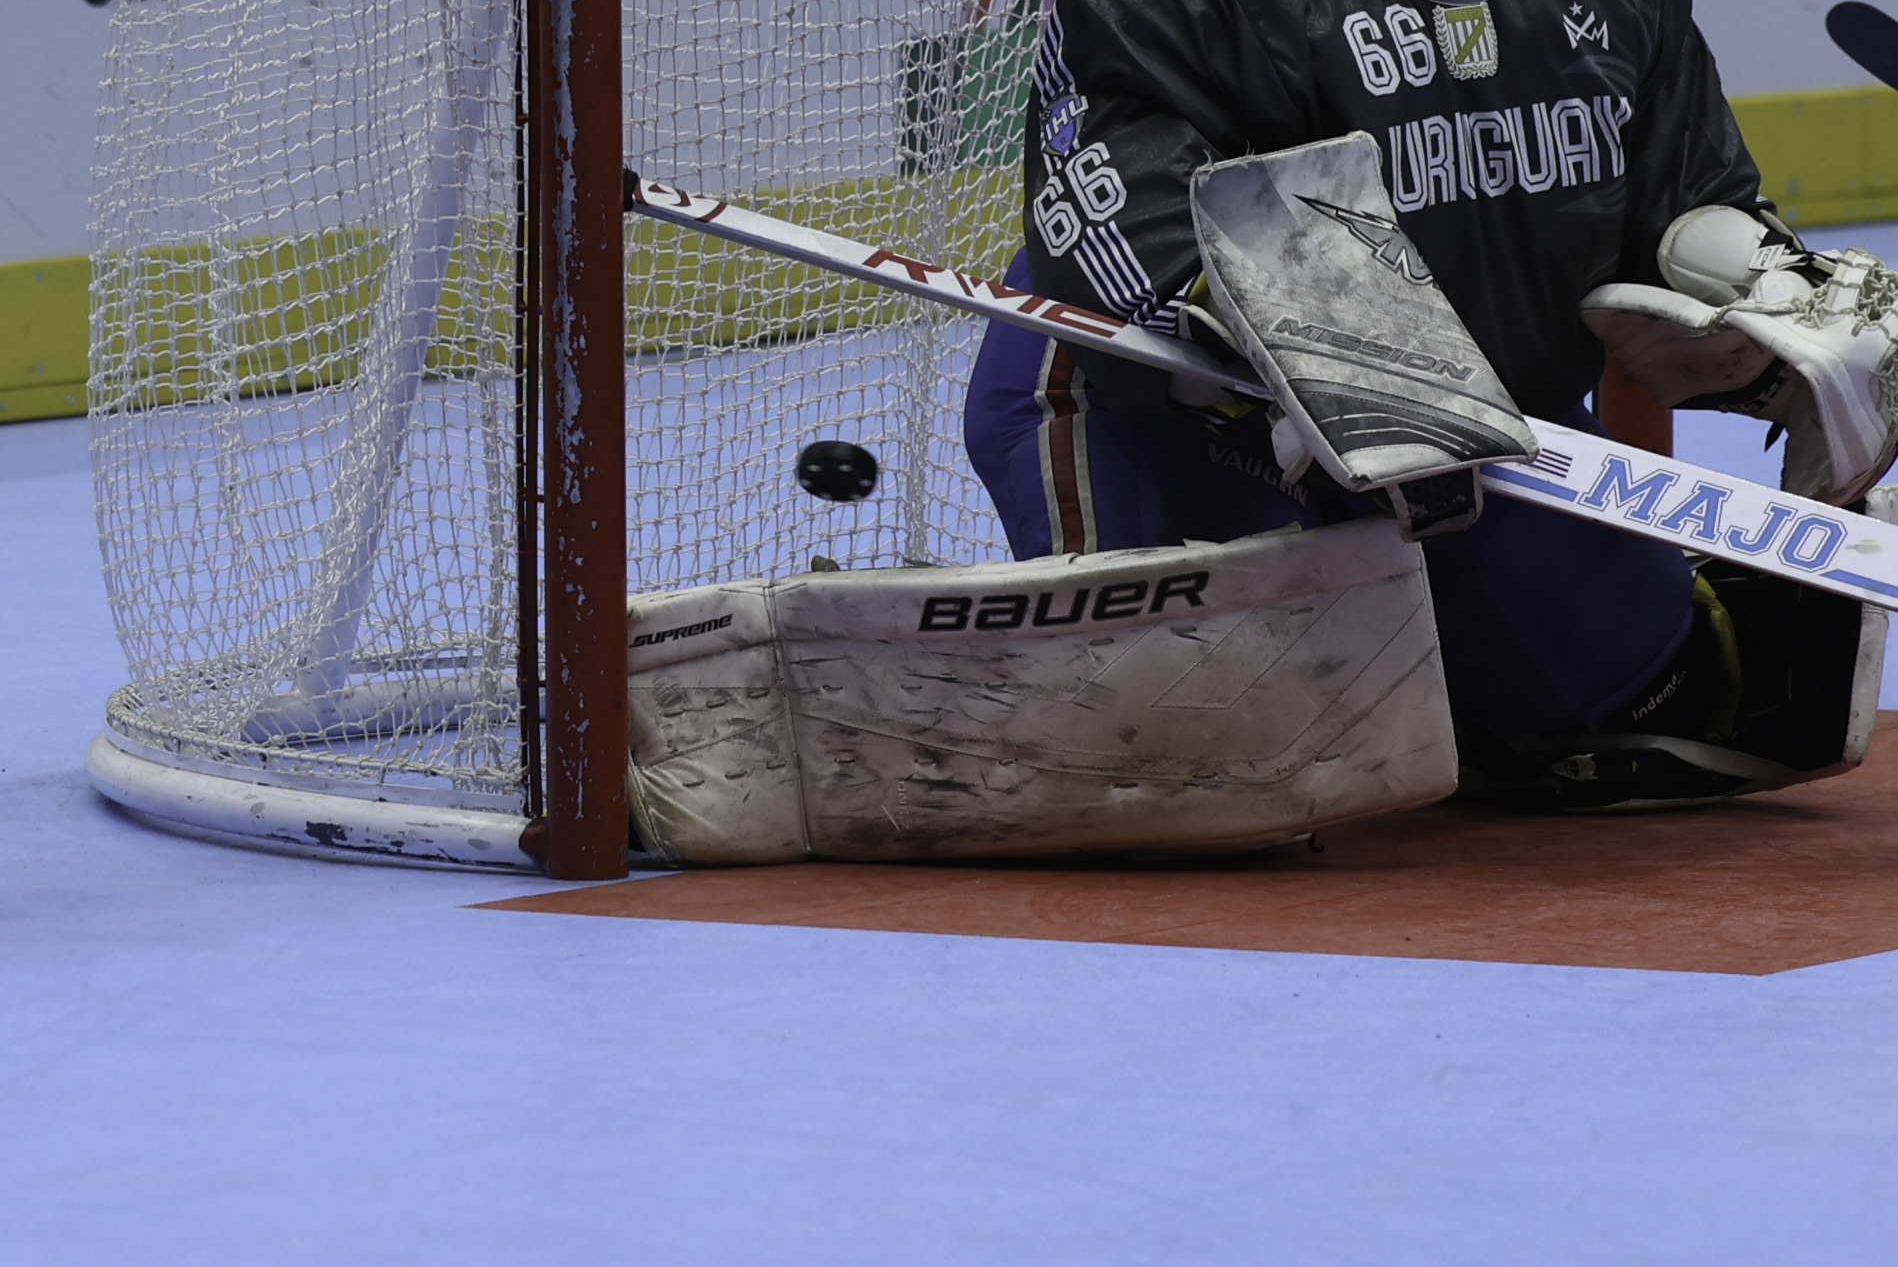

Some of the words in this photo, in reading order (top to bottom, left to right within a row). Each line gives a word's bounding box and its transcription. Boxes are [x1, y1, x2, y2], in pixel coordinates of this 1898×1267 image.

[1342, 3, 1438, 97] 66
[1044, 95, 1090, 142] IHU
[1032, 141, 1128, 258] 66
[1269, 315, 1481, 384] MISSION
[1577, 453, 1849, 574] MAJO
[627, 613, 733, 649] SUPREME
[917, 570, 1211, 633] BAUER
